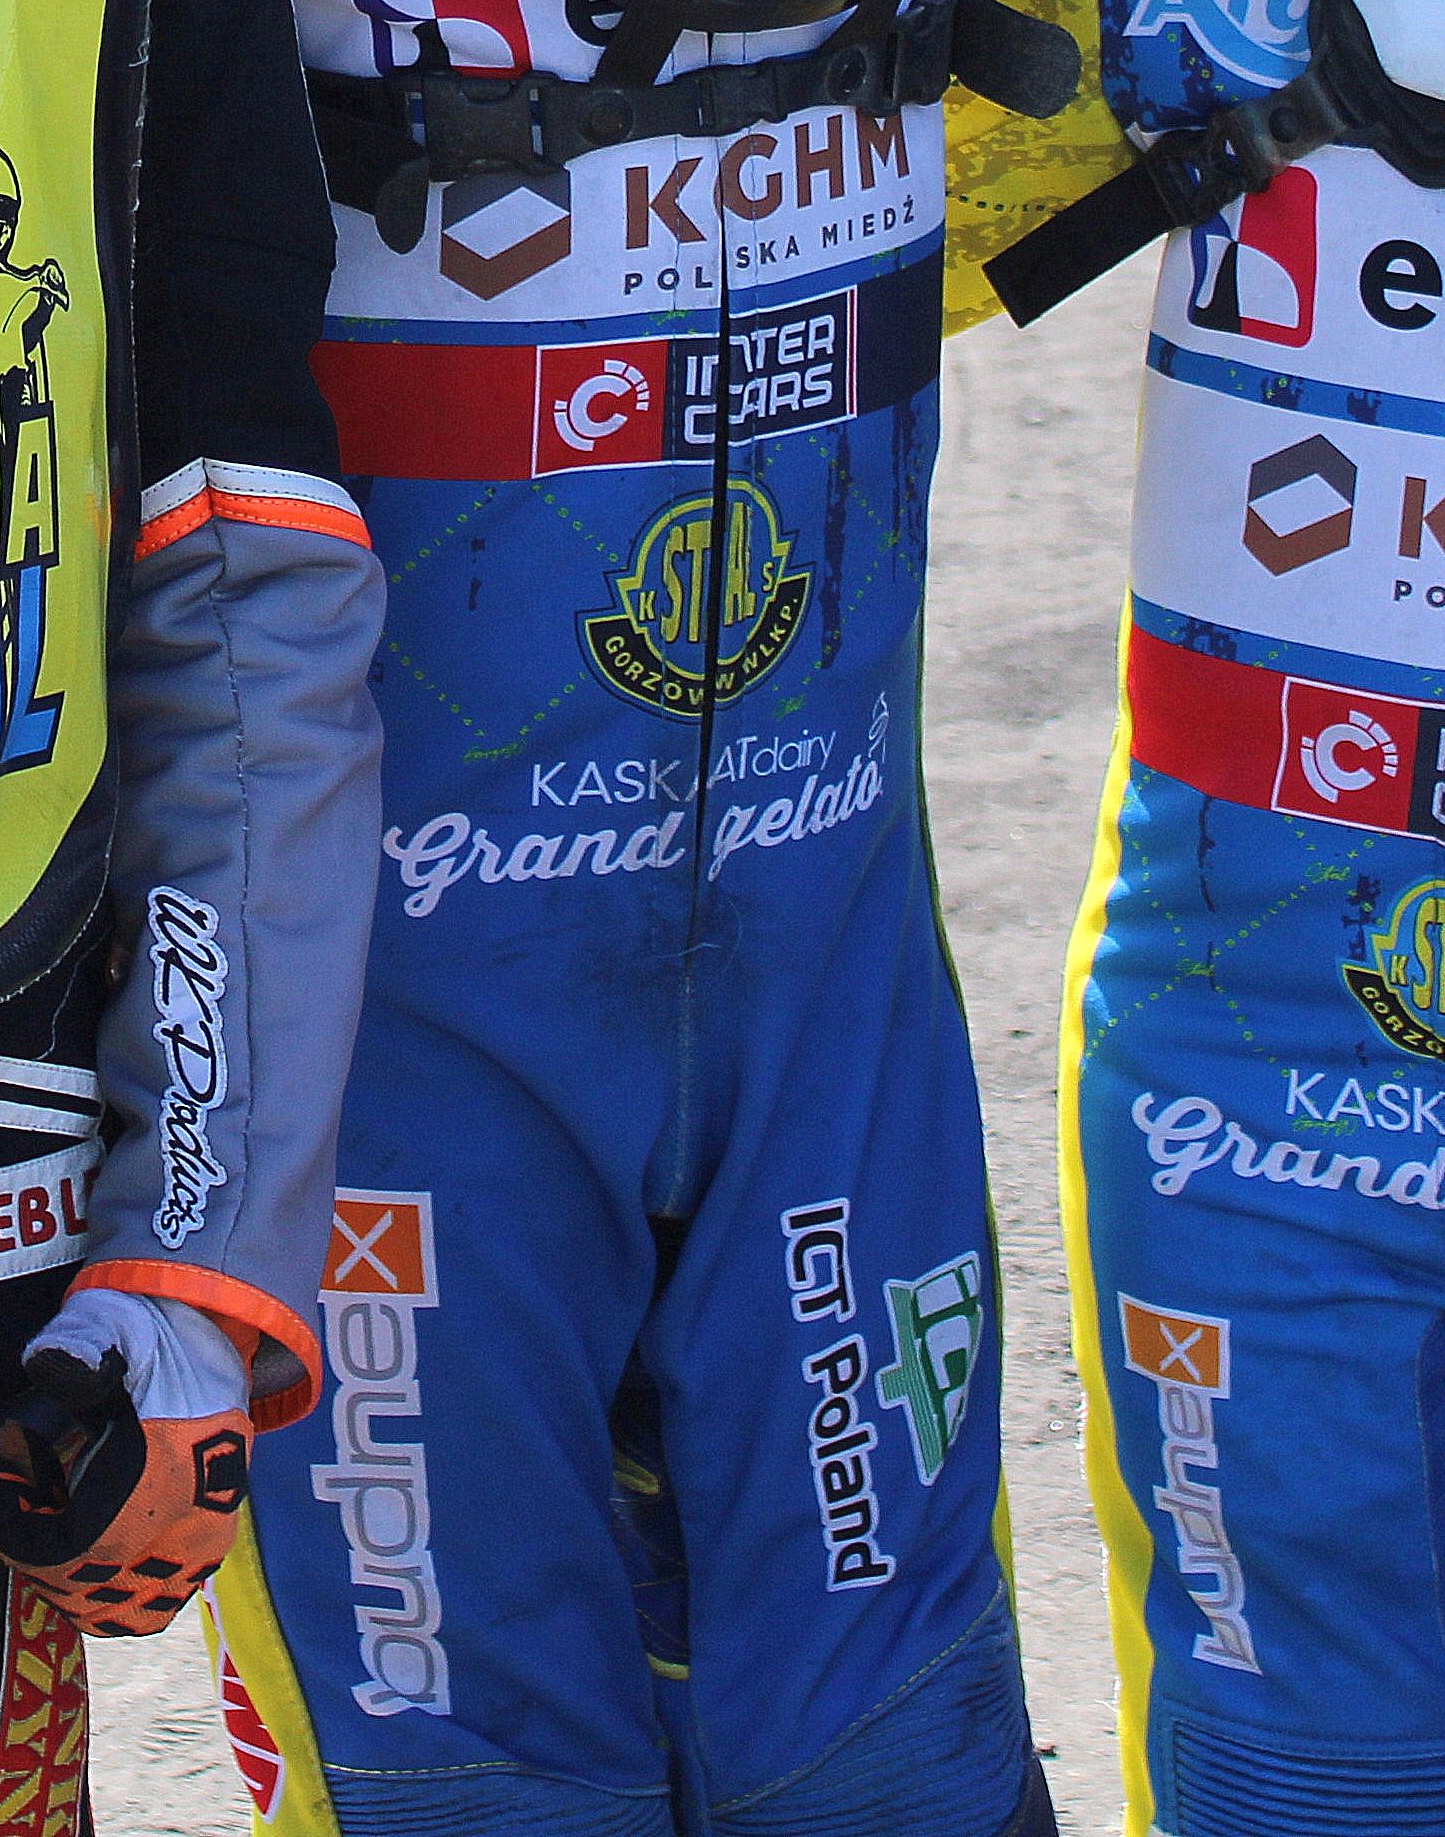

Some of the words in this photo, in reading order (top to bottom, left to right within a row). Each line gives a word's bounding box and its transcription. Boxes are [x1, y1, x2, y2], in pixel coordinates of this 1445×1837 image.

[623, 229, 801, 296] POLSKA
[821, 196, 916, 249] MIEDŹ
[624, 113, 911, 251] KGHM
[660, 501, 757, 645] STAL
[383, 809, 687, 919] Grand
[708, 752, 886, 882] gelato
[809, 1341, 890, 1586] Poland
